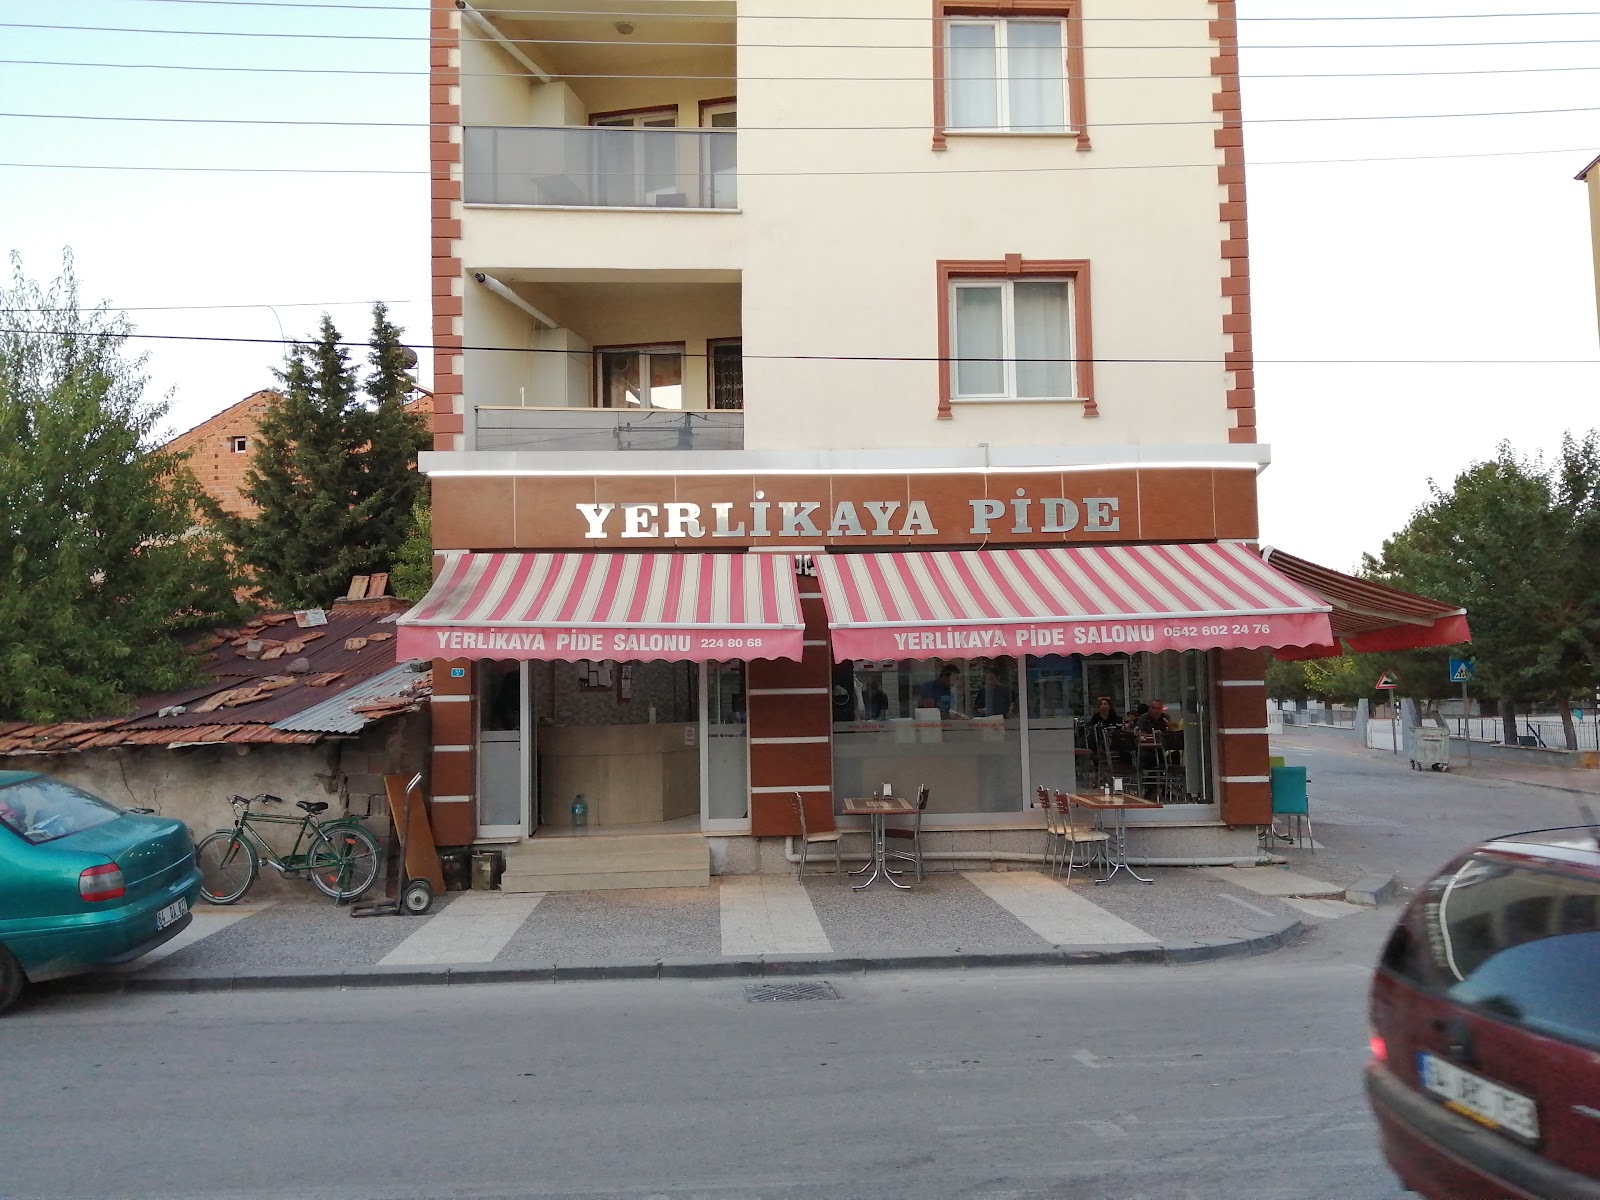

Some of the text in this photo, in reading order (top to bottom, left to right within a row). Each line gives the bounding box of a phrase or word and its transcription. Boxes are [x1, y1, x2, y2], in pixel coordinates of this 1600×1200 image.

[575, 487, 1120, 539] YERLİKAYA PİDE
[437, 628, 763, 652] YERLİKAYA PİDE SALONU 224 80 68
[893, 623, 1271, 651] YERLİKAYA PİDE SALONU 0542 602 24 76
